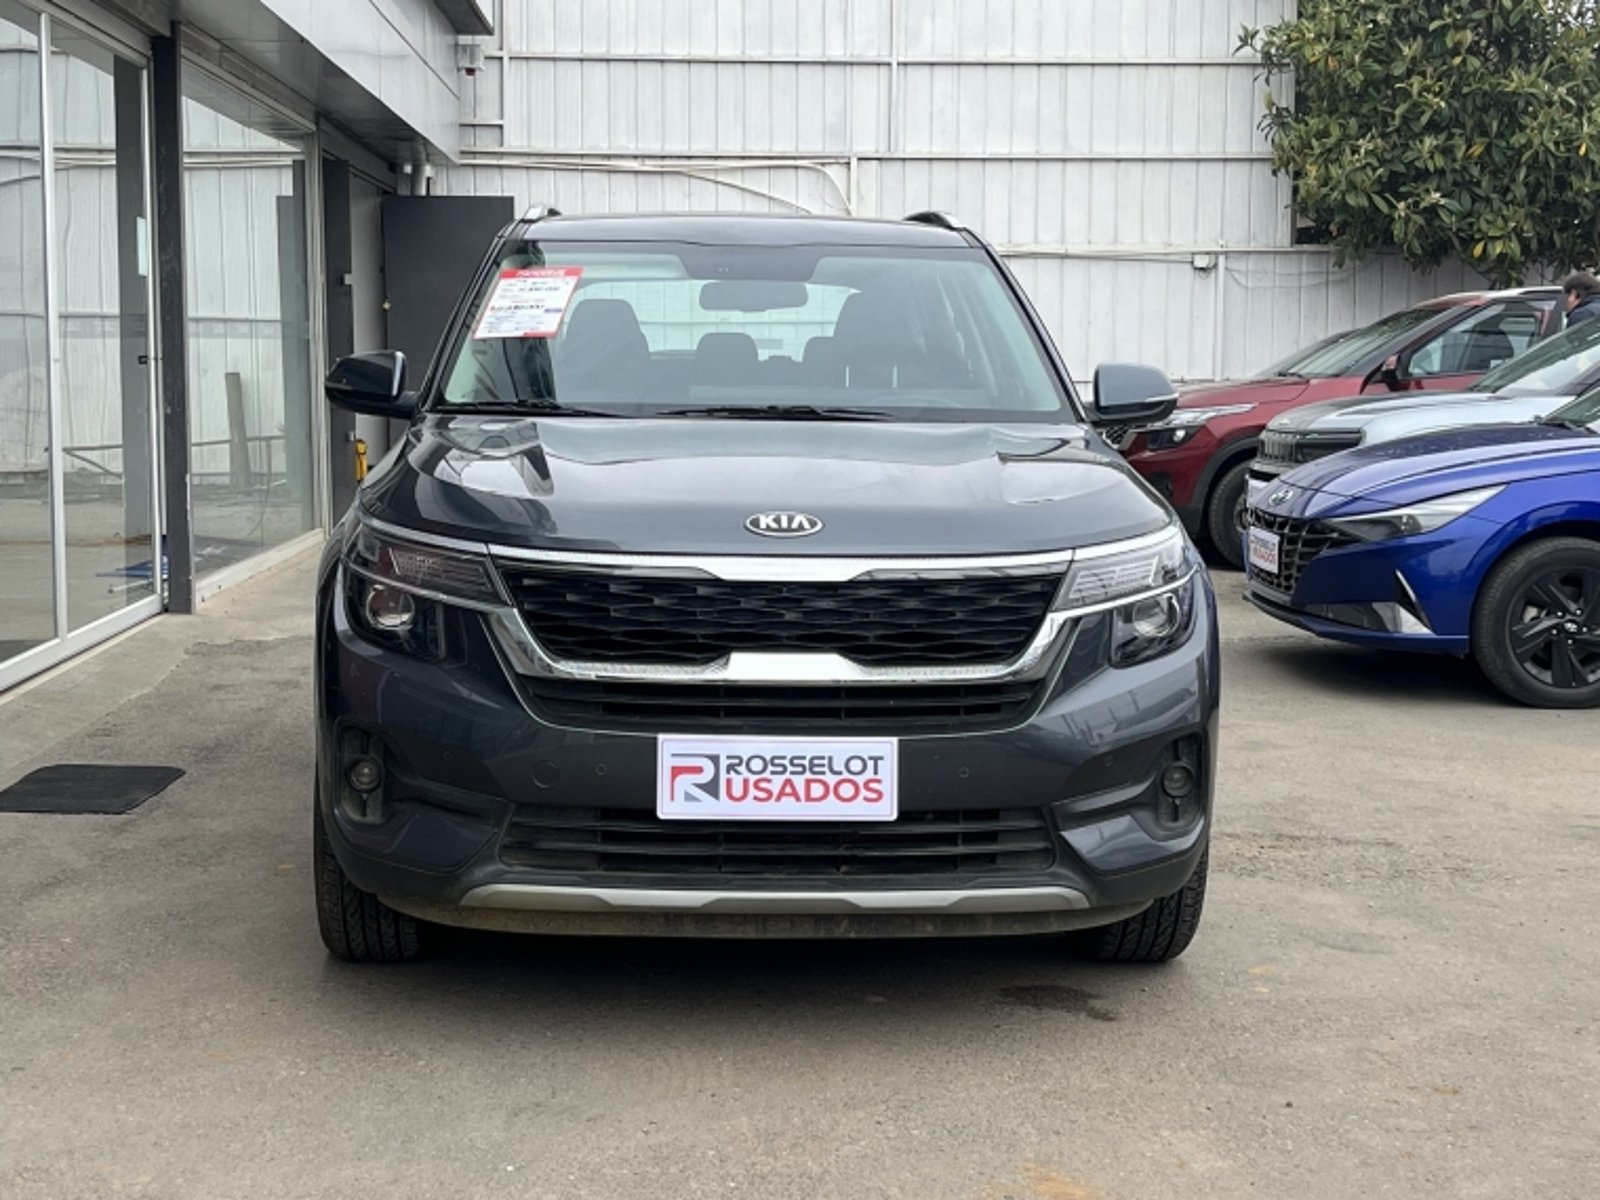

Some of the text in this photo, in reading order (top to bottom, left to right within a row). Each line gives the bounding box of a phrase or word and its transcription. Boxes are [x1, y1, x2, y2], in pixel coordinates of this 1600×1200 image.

[758, 514, 811, 529] KIA
[726, 755, 884, 775] ROSSELOT
[726, 778, 883, 803] USADOS
